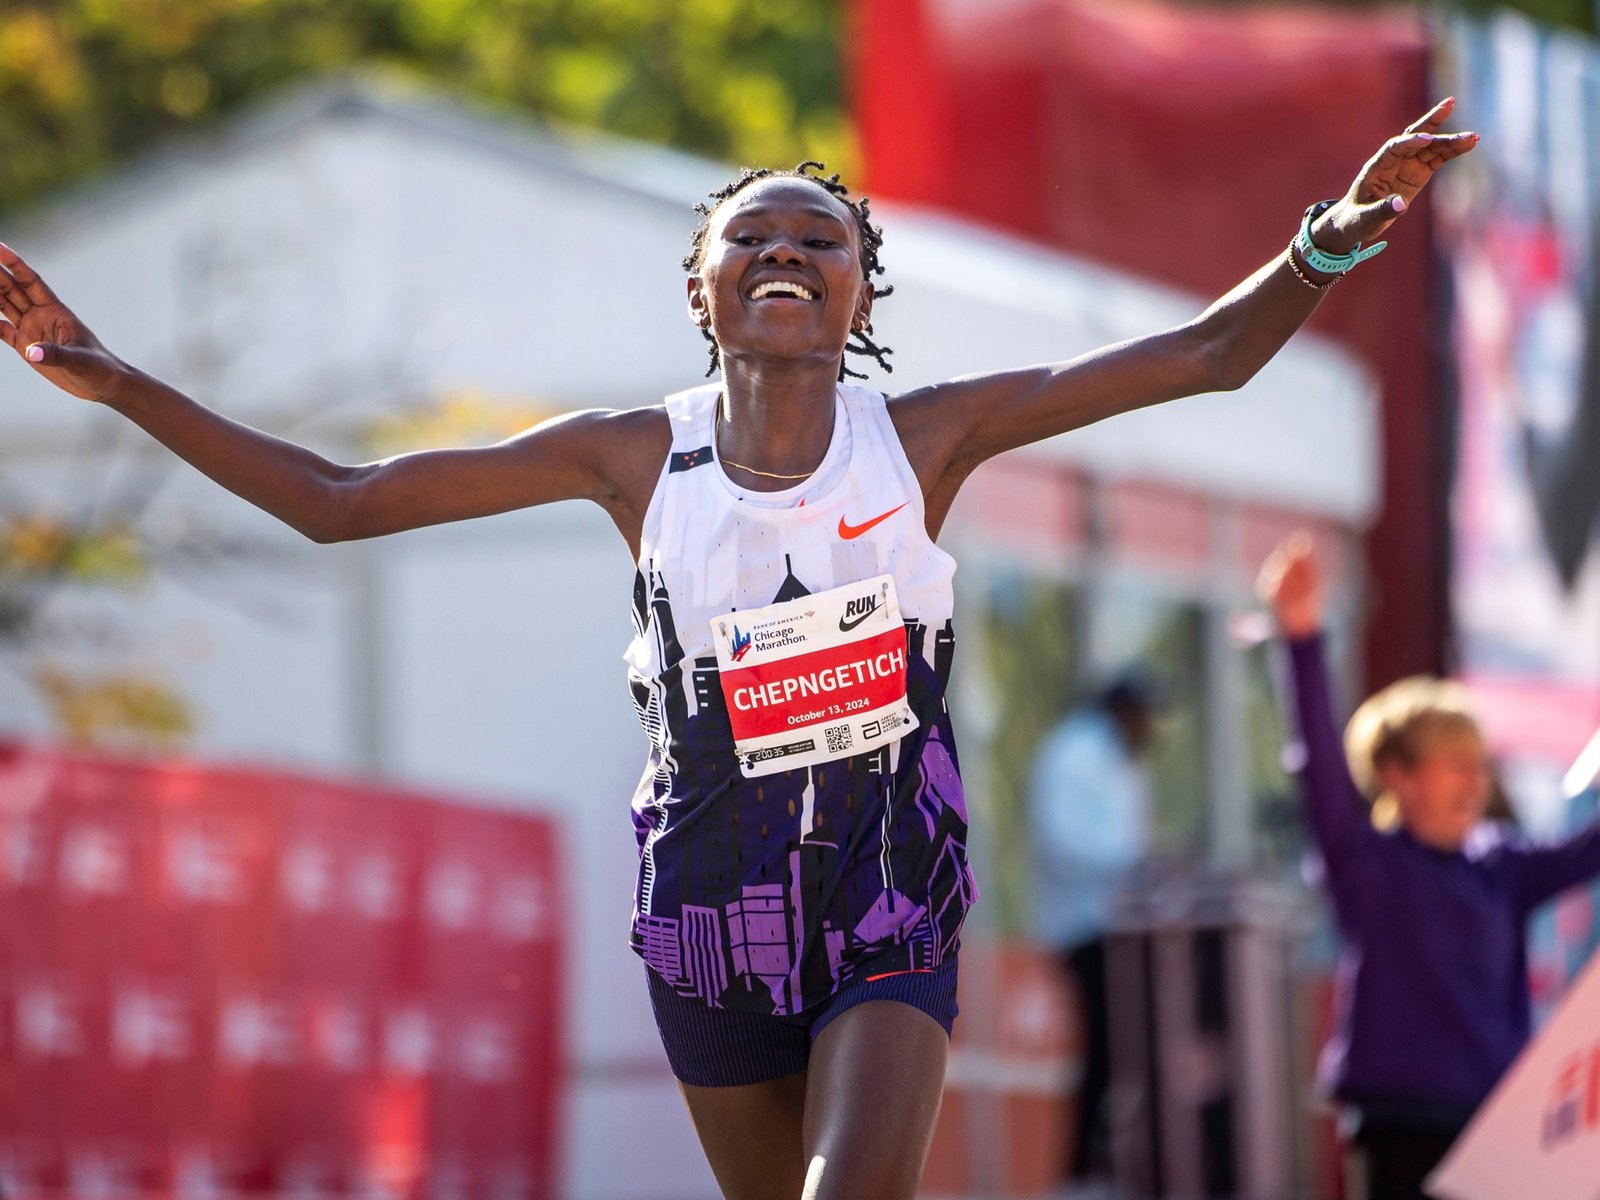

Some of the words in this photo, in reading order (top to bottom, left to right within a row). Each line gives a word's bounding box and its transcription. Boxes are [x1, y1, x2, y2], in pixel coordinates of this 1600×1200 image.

[846, 594, 876, 617] RUN
[777, 615, 803, 625] AMERICA
[754, 627, 794, 642] Chicago
[734, 649, 904, 711] CHEPNGETICH
[787, 709, 826, 726] October
[828, 703, 845, 716] 13,
[846, 697, 870, 711] 2024
